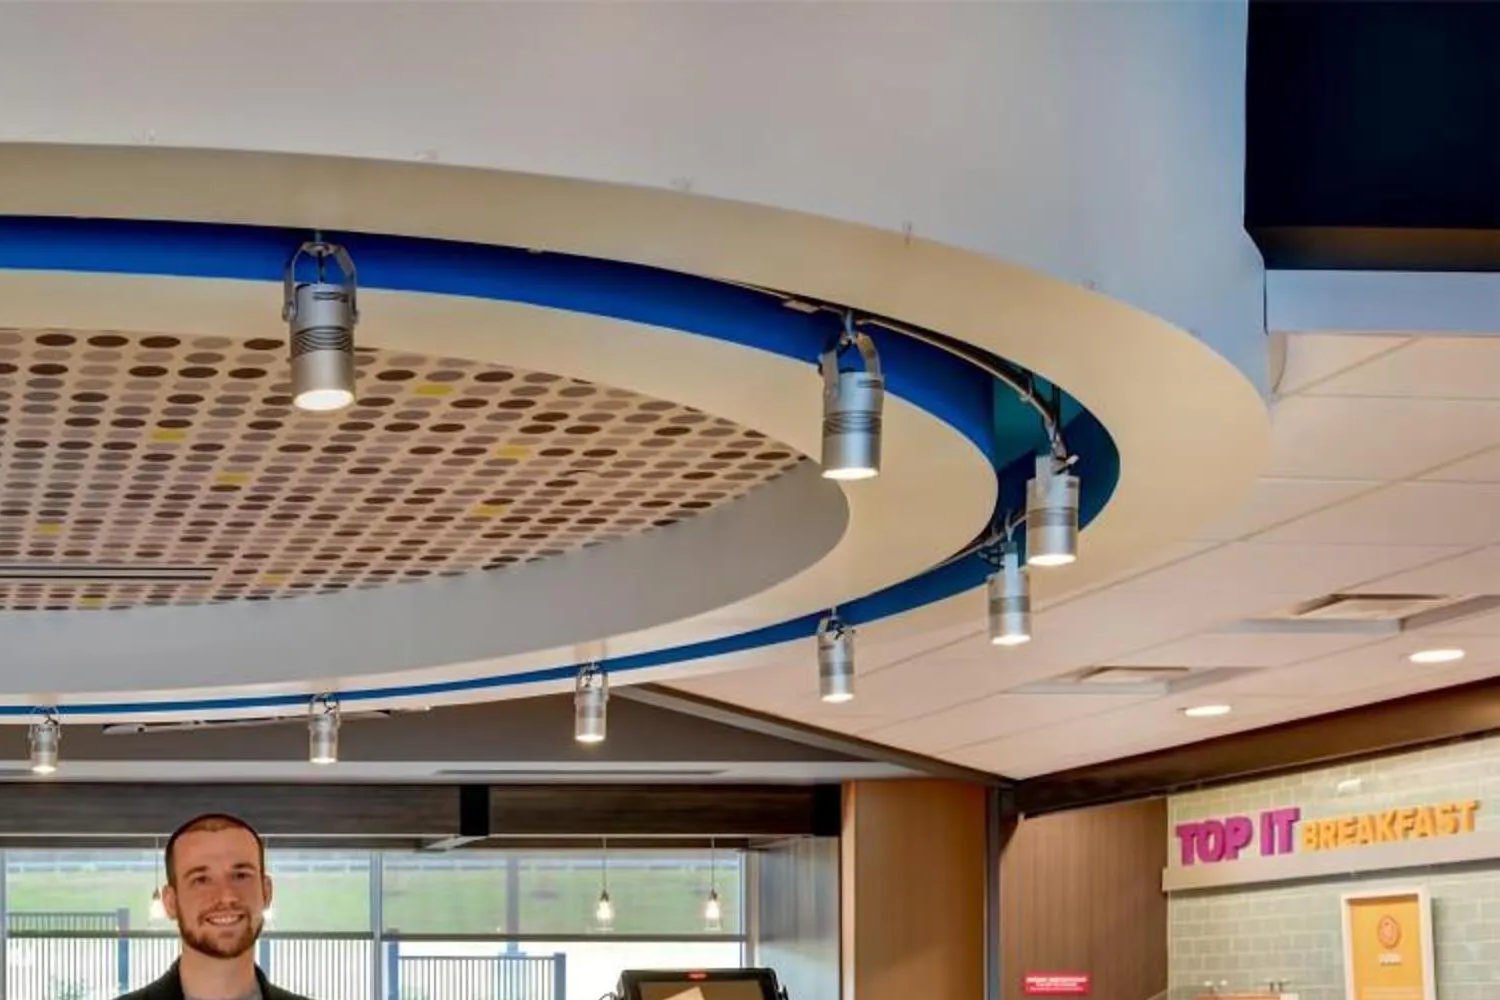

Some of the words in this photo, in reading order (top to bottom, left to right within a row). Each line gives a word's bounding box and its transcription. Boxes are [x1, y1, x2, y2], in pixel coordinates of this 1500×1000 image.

[1176, 816, 1253, 866] TOP
[1260, 807, 1300, 857] IT
[1302, 800, 1479, 851] BREAKFAST
